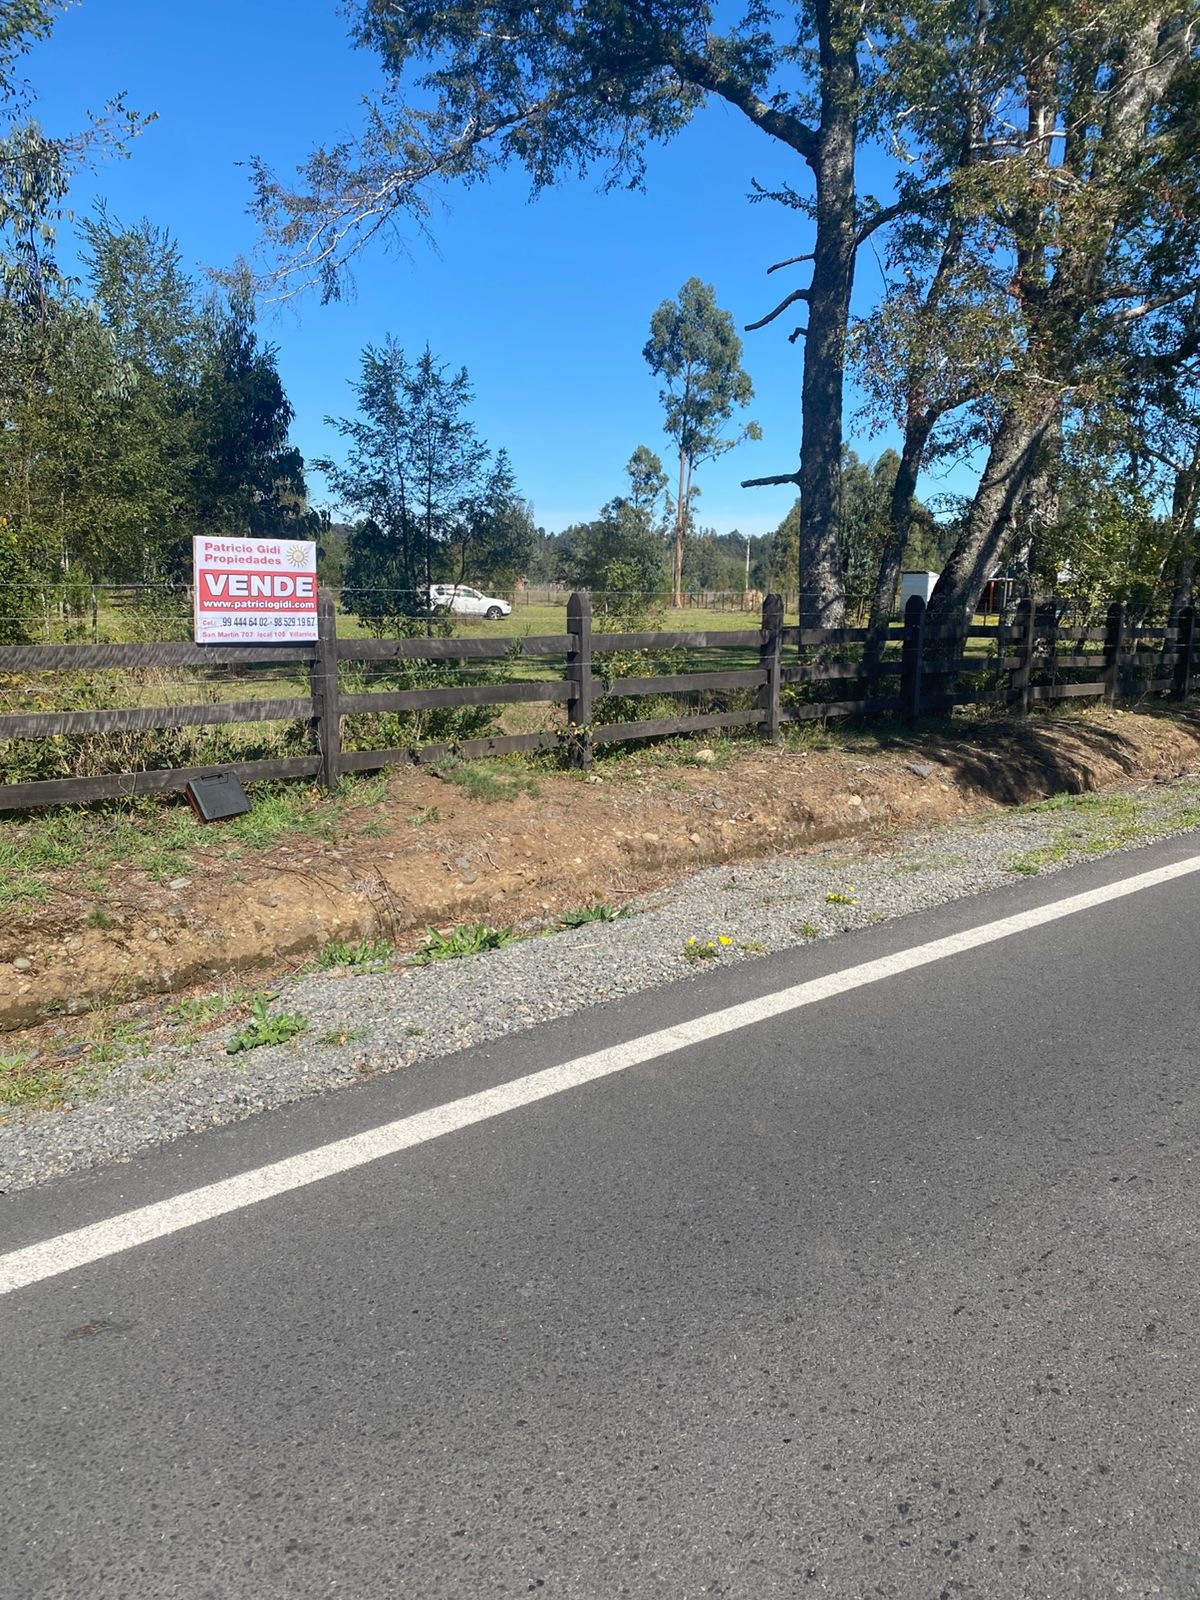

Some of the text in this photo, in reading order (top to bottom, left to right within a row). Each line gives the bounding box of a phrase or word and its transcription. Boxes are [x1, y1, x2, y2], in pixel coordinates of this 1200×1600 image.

[205, 543, 280, 554] Patricio Gidi
[205, 554, 281, 564] Propiedades
[205, 574, 313, 597] VENDE
[203, 600, 314, 608] www.patriciogidi.com
[222, 617, 232, 626] 99
[234, 618, 246, 626] 444
[259, 618, 268, 626] 02
[284, 618, 296, 626] 529
[298, 618, 305, 626] 19
[307, 618, 315, 626] 67
